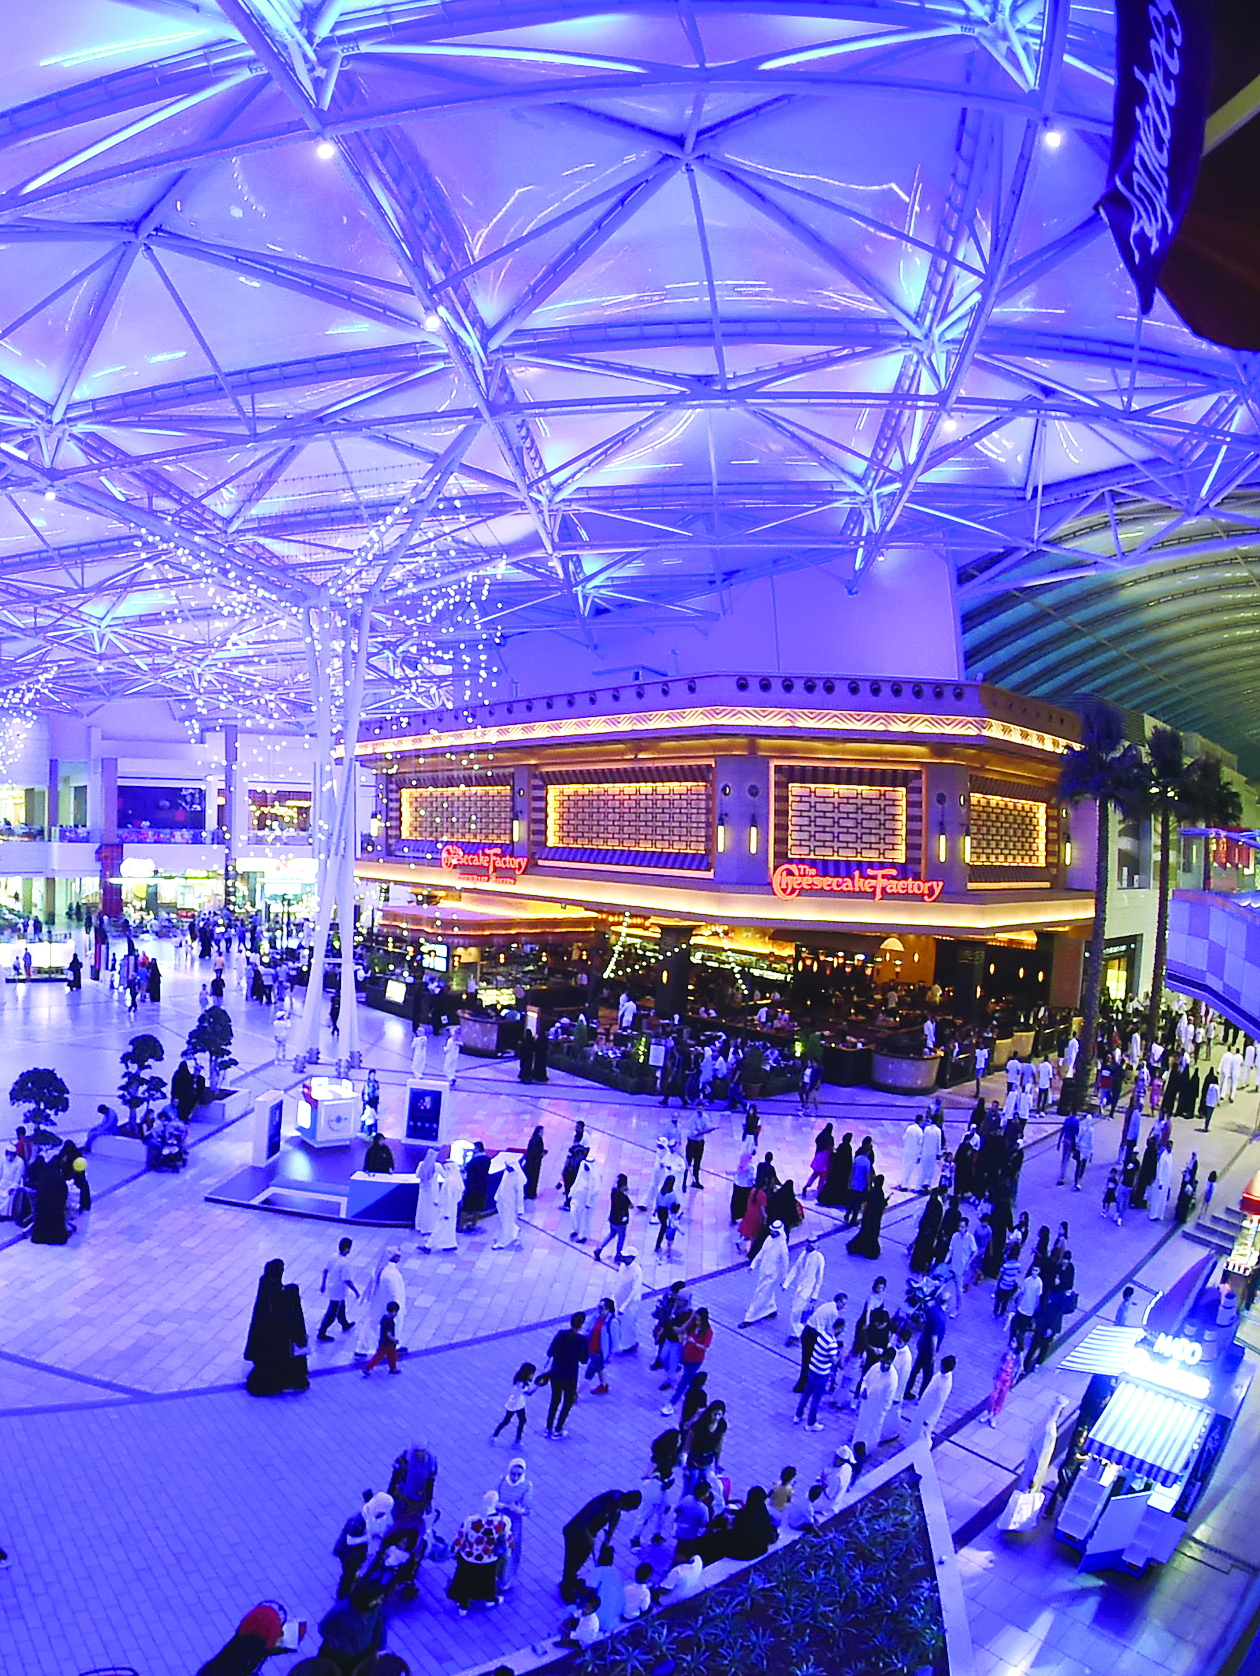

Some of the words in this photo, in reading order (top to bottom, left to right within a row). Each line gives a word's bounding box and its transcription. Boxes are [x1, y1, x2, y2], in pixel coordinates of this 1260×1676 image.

[484, 847, 529, 876] Factory
[797, 864, 817, 876] The
[772, 863, 877, 901] Cheesecake
[866, 868, 944, 902] Factory
